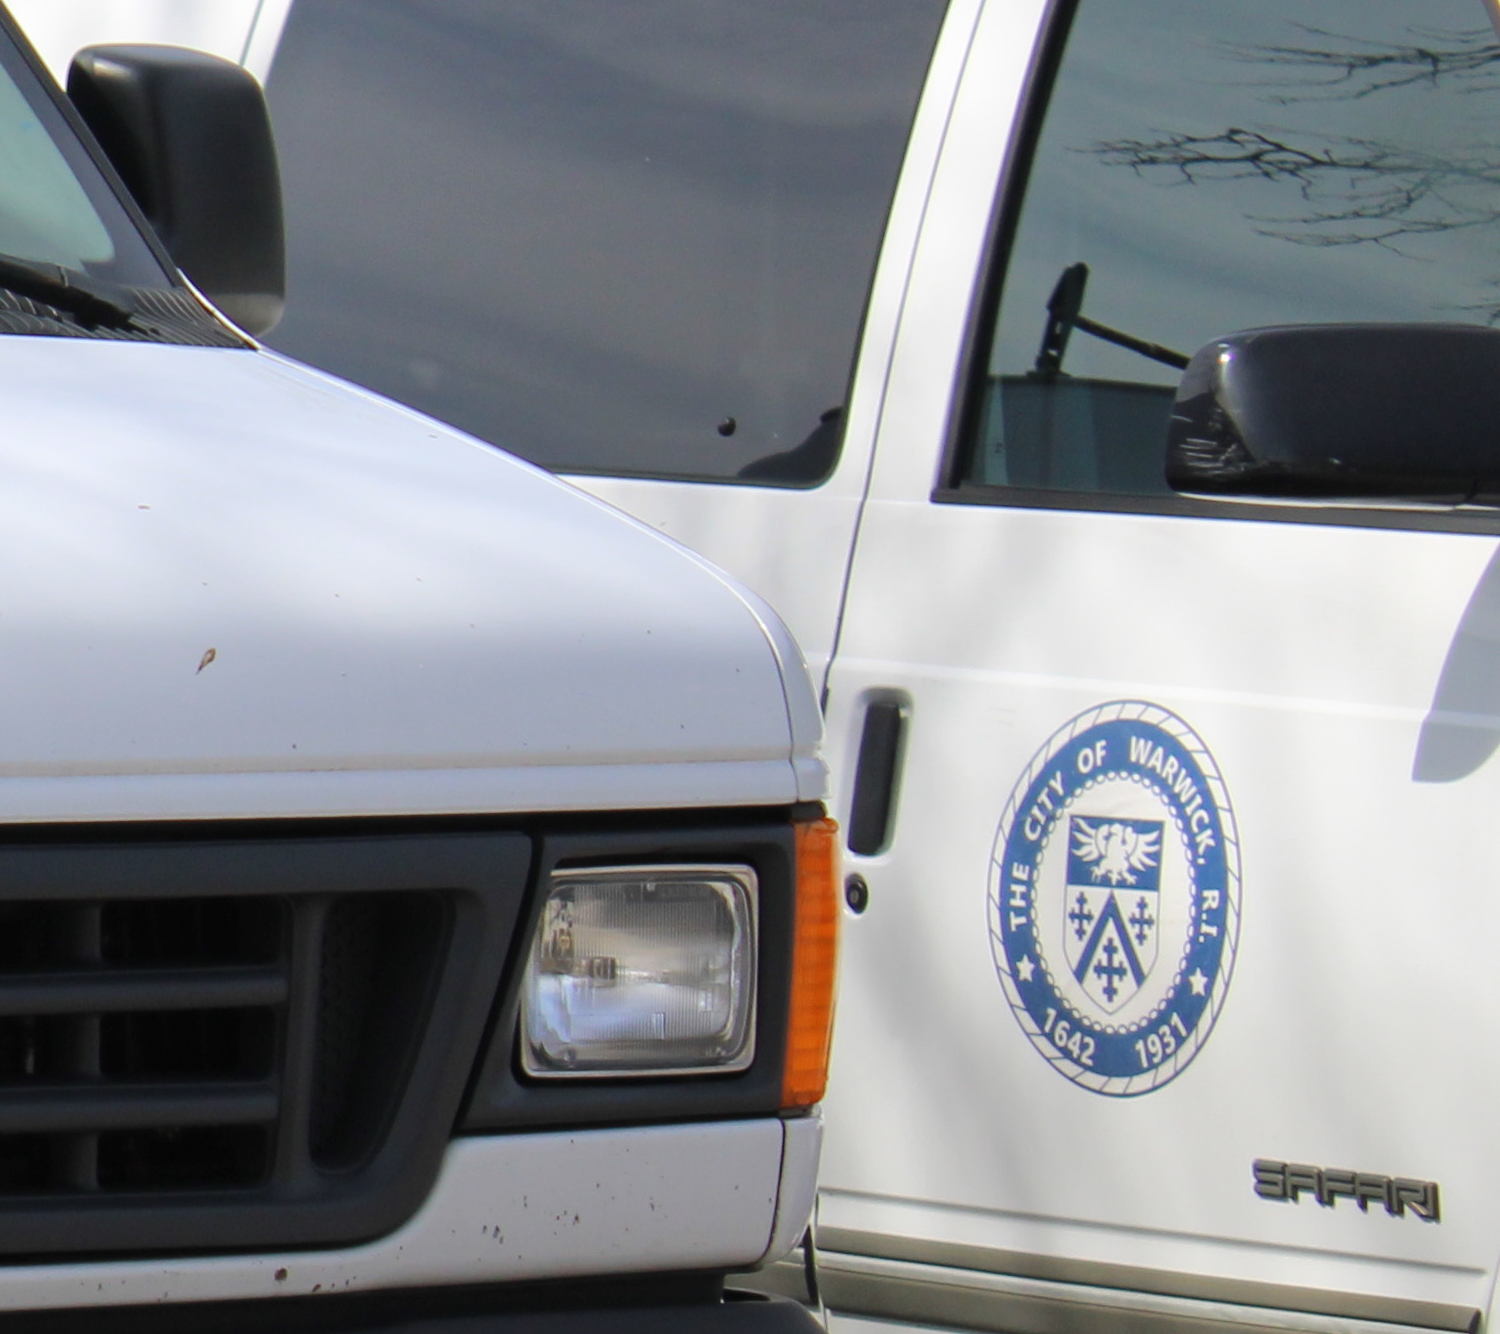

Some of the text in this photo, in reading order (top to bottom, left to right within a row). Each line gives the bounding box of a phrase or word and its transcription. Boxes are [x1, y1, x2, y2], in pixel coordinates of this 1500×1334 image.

[1010, 862, 1029, 932] THE
[1023, 771, 1066, 842] CITY
[1077, 740, 1108, 775] OF
[1198, 889, 1219, 944] R.I.
[1042, 1007, 1189, 1068] 1642 1931
[1252, 1158, 1441, 1224] SAFARI
